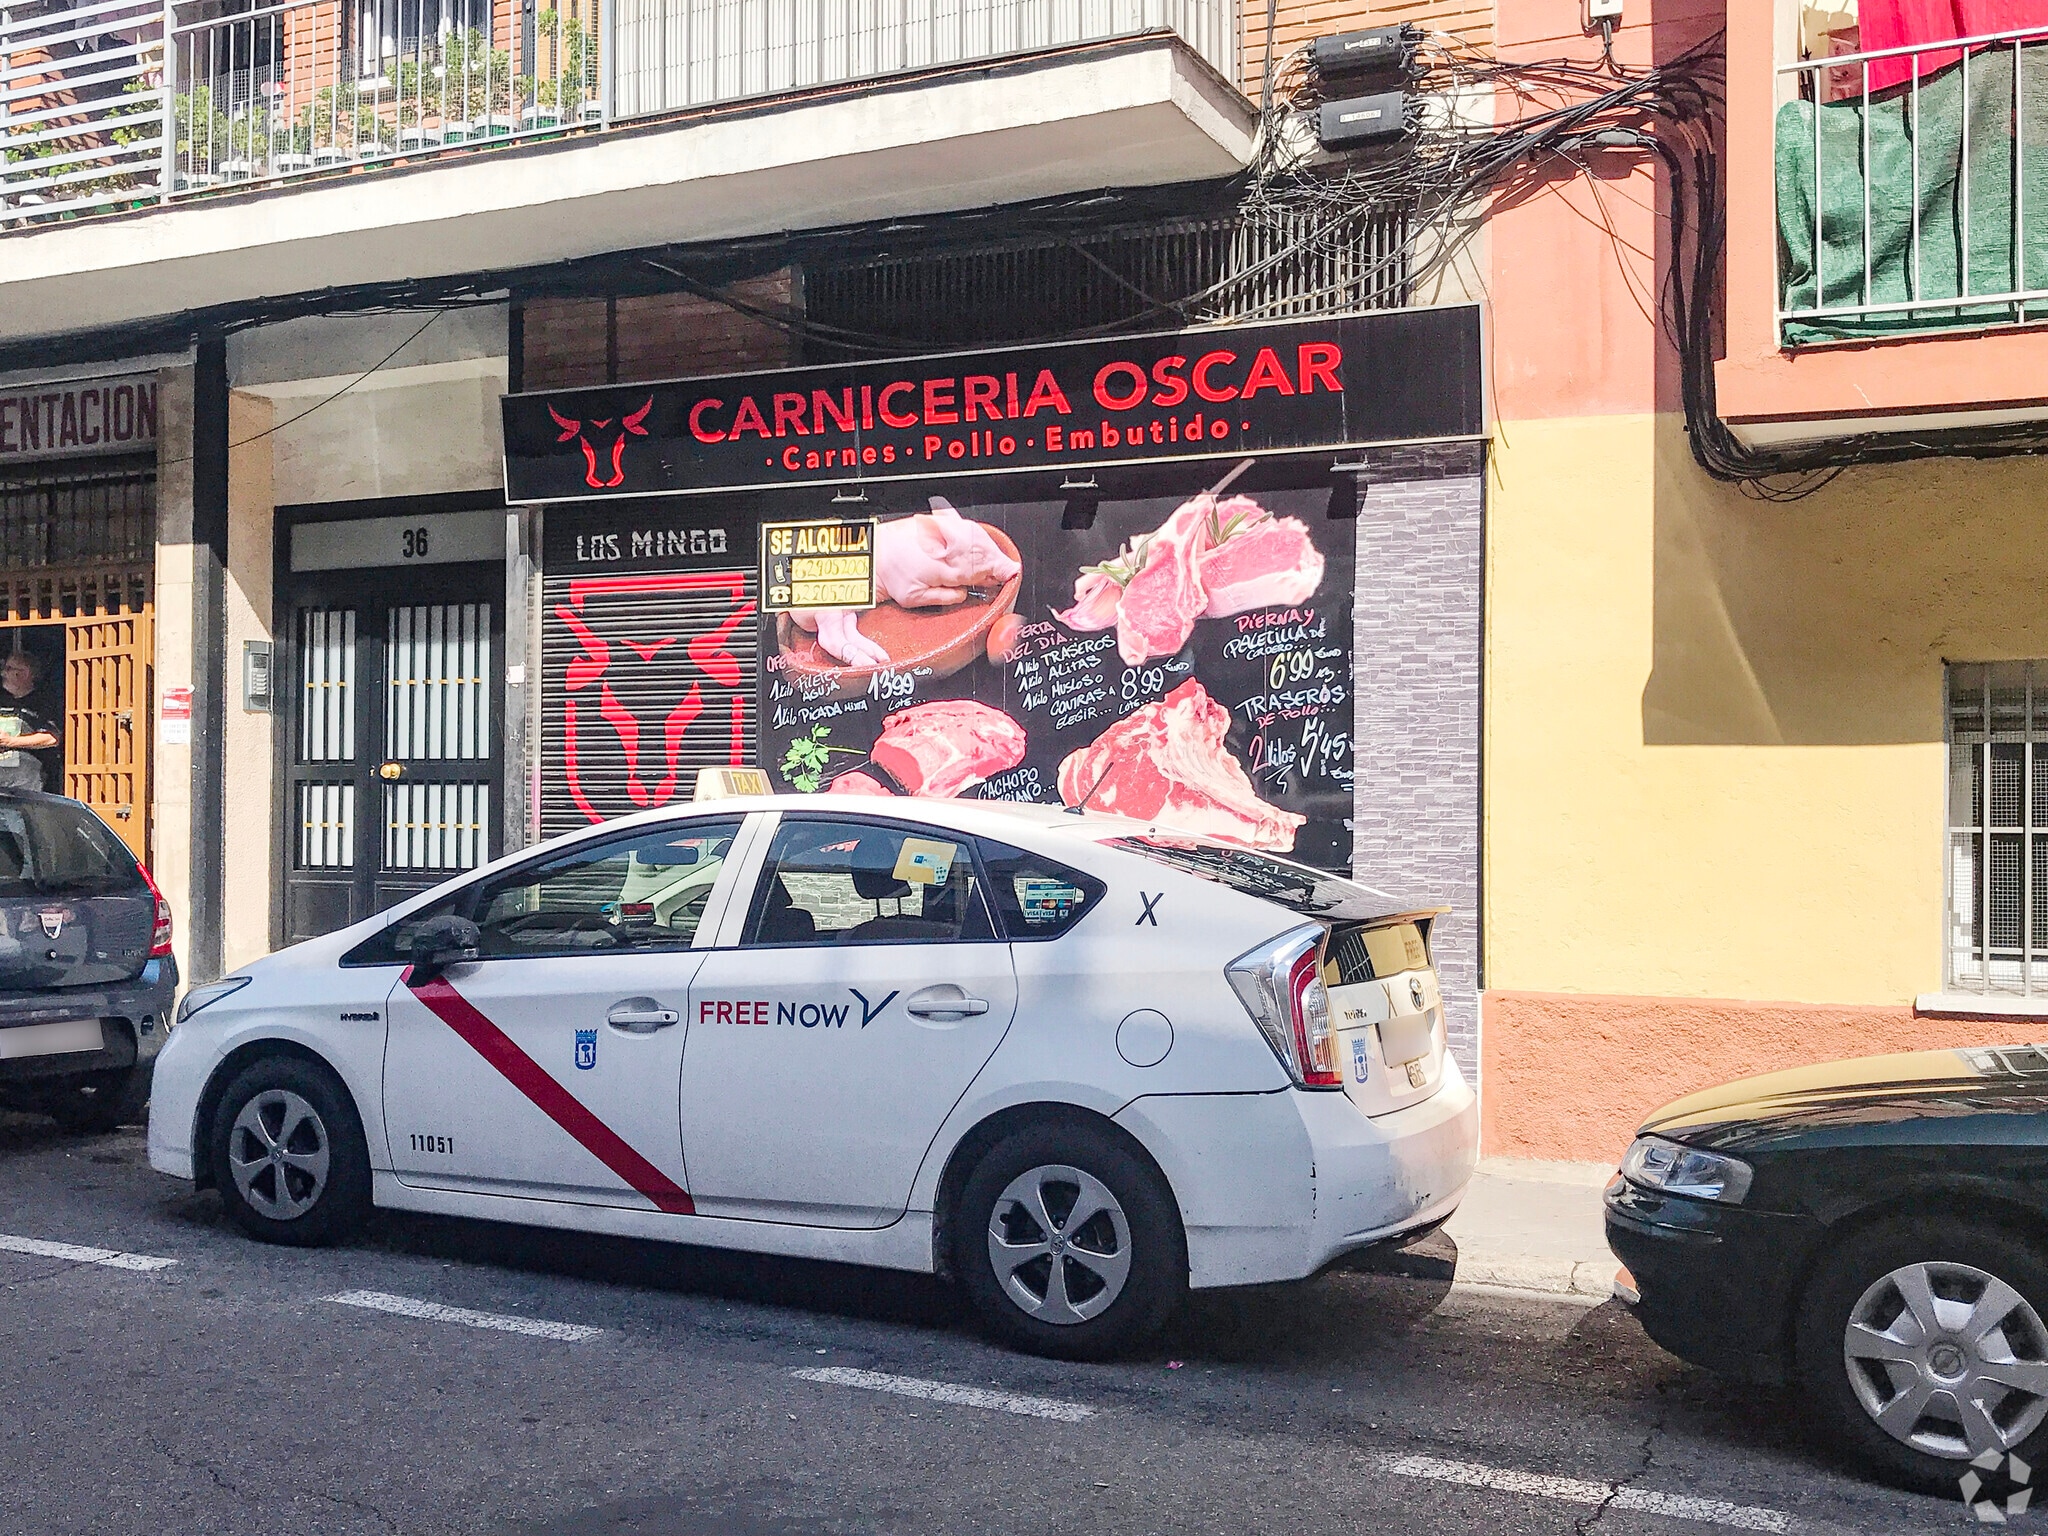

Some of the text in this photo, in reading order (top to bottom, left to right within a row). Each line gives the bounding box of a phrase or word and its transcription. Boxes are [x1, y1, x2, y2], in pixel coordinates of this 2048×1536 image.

[688, 341, 1344, 444] CARNICERIA OSCAR
[0, 382, 157, 452] ENTACION
[782, 411, 1230, 471] Carnes Pollo Embutido
[403, 527, 428, 558] 36
[576, 528, 728, 562] LOS MINGO
[770, 525, 869, 556] SE ALQUILA
[1013, 621, 1056, 641] FERTA
[1000, 641, 1034, 664] DEL
[1040, 634, 1117, 667] TRASEROS
[1234, 684, 1346, 722] TRASEROS
[732, 773, 763, 794] TAXI
[1134, 891, 1164, 927] X
[700, 1001, 850, 1028] FREE NOW
[410, 1134, 453, 1155] 11051
